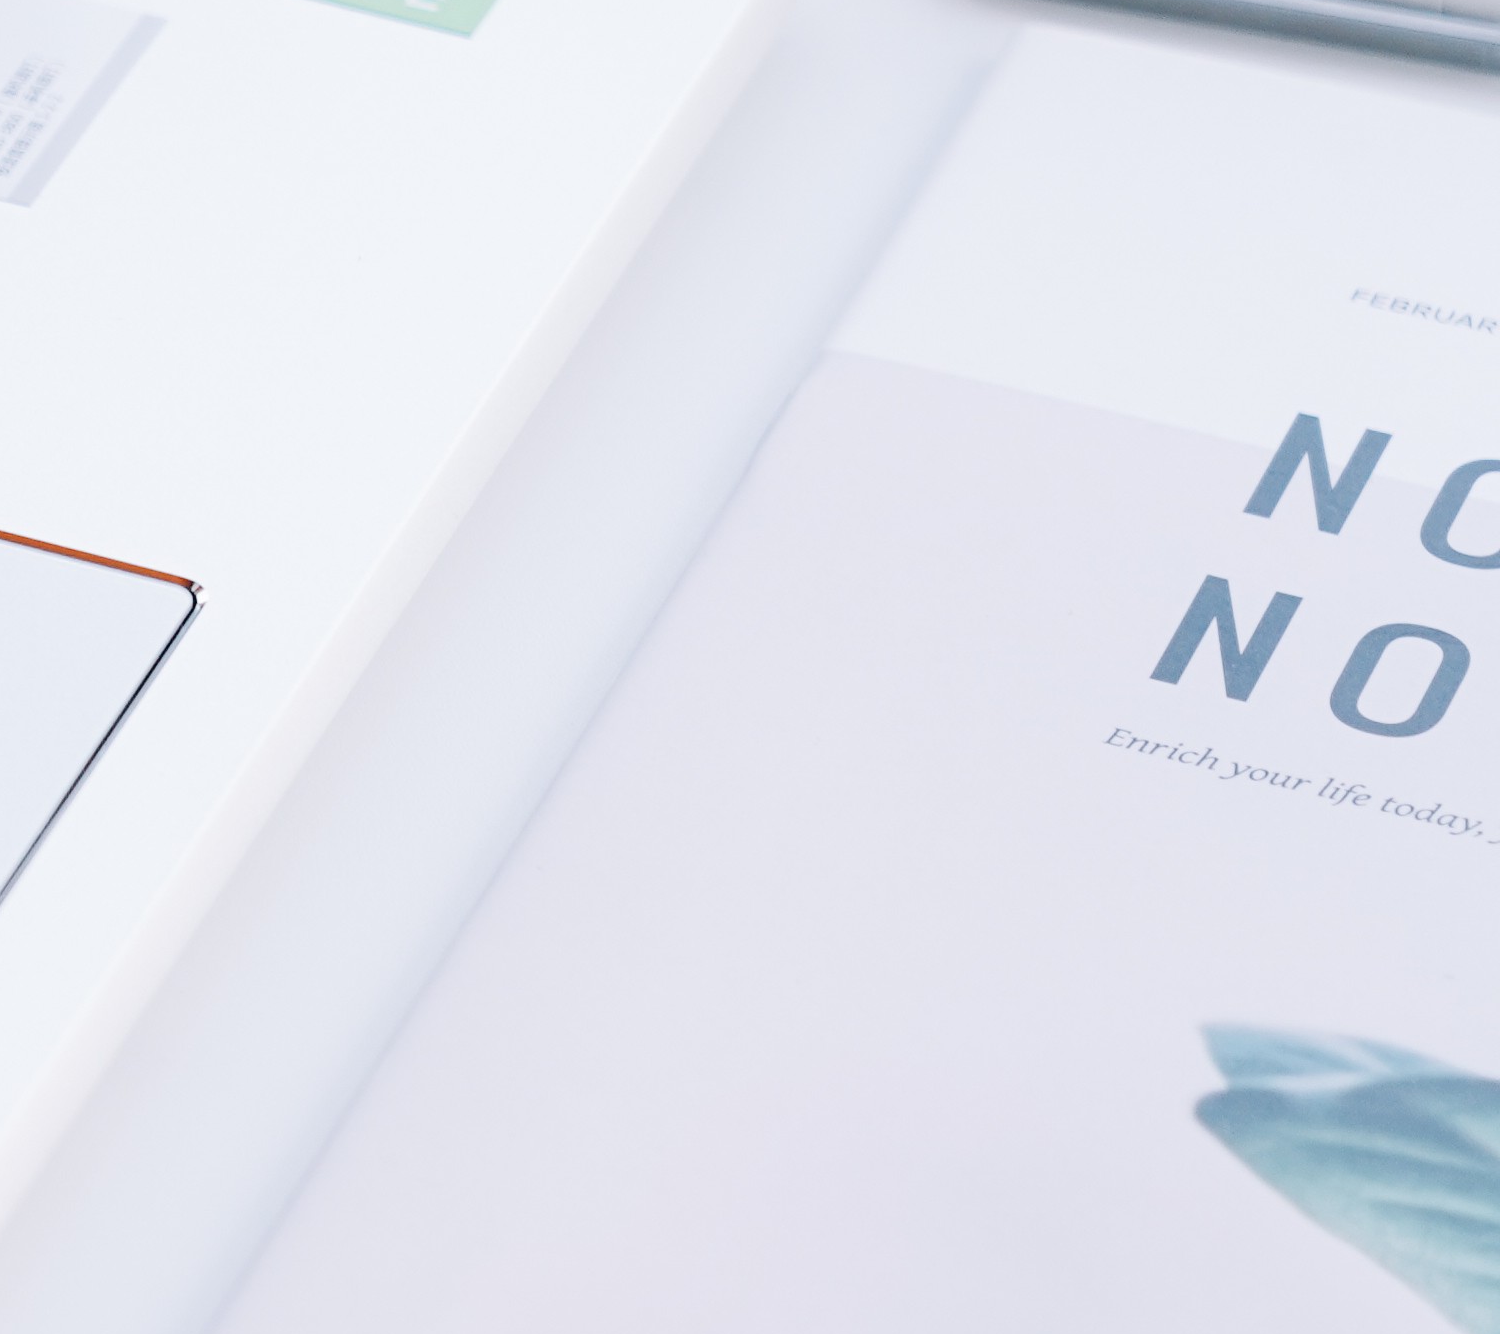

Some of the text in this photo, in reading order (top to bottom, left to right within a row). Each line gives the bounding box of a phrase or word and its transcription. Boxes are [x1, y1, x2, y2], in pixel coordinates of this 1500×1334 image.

[1149, 574, 1472, 739] NO
[1102, 727, 1485, 838] Enrich your life today,
